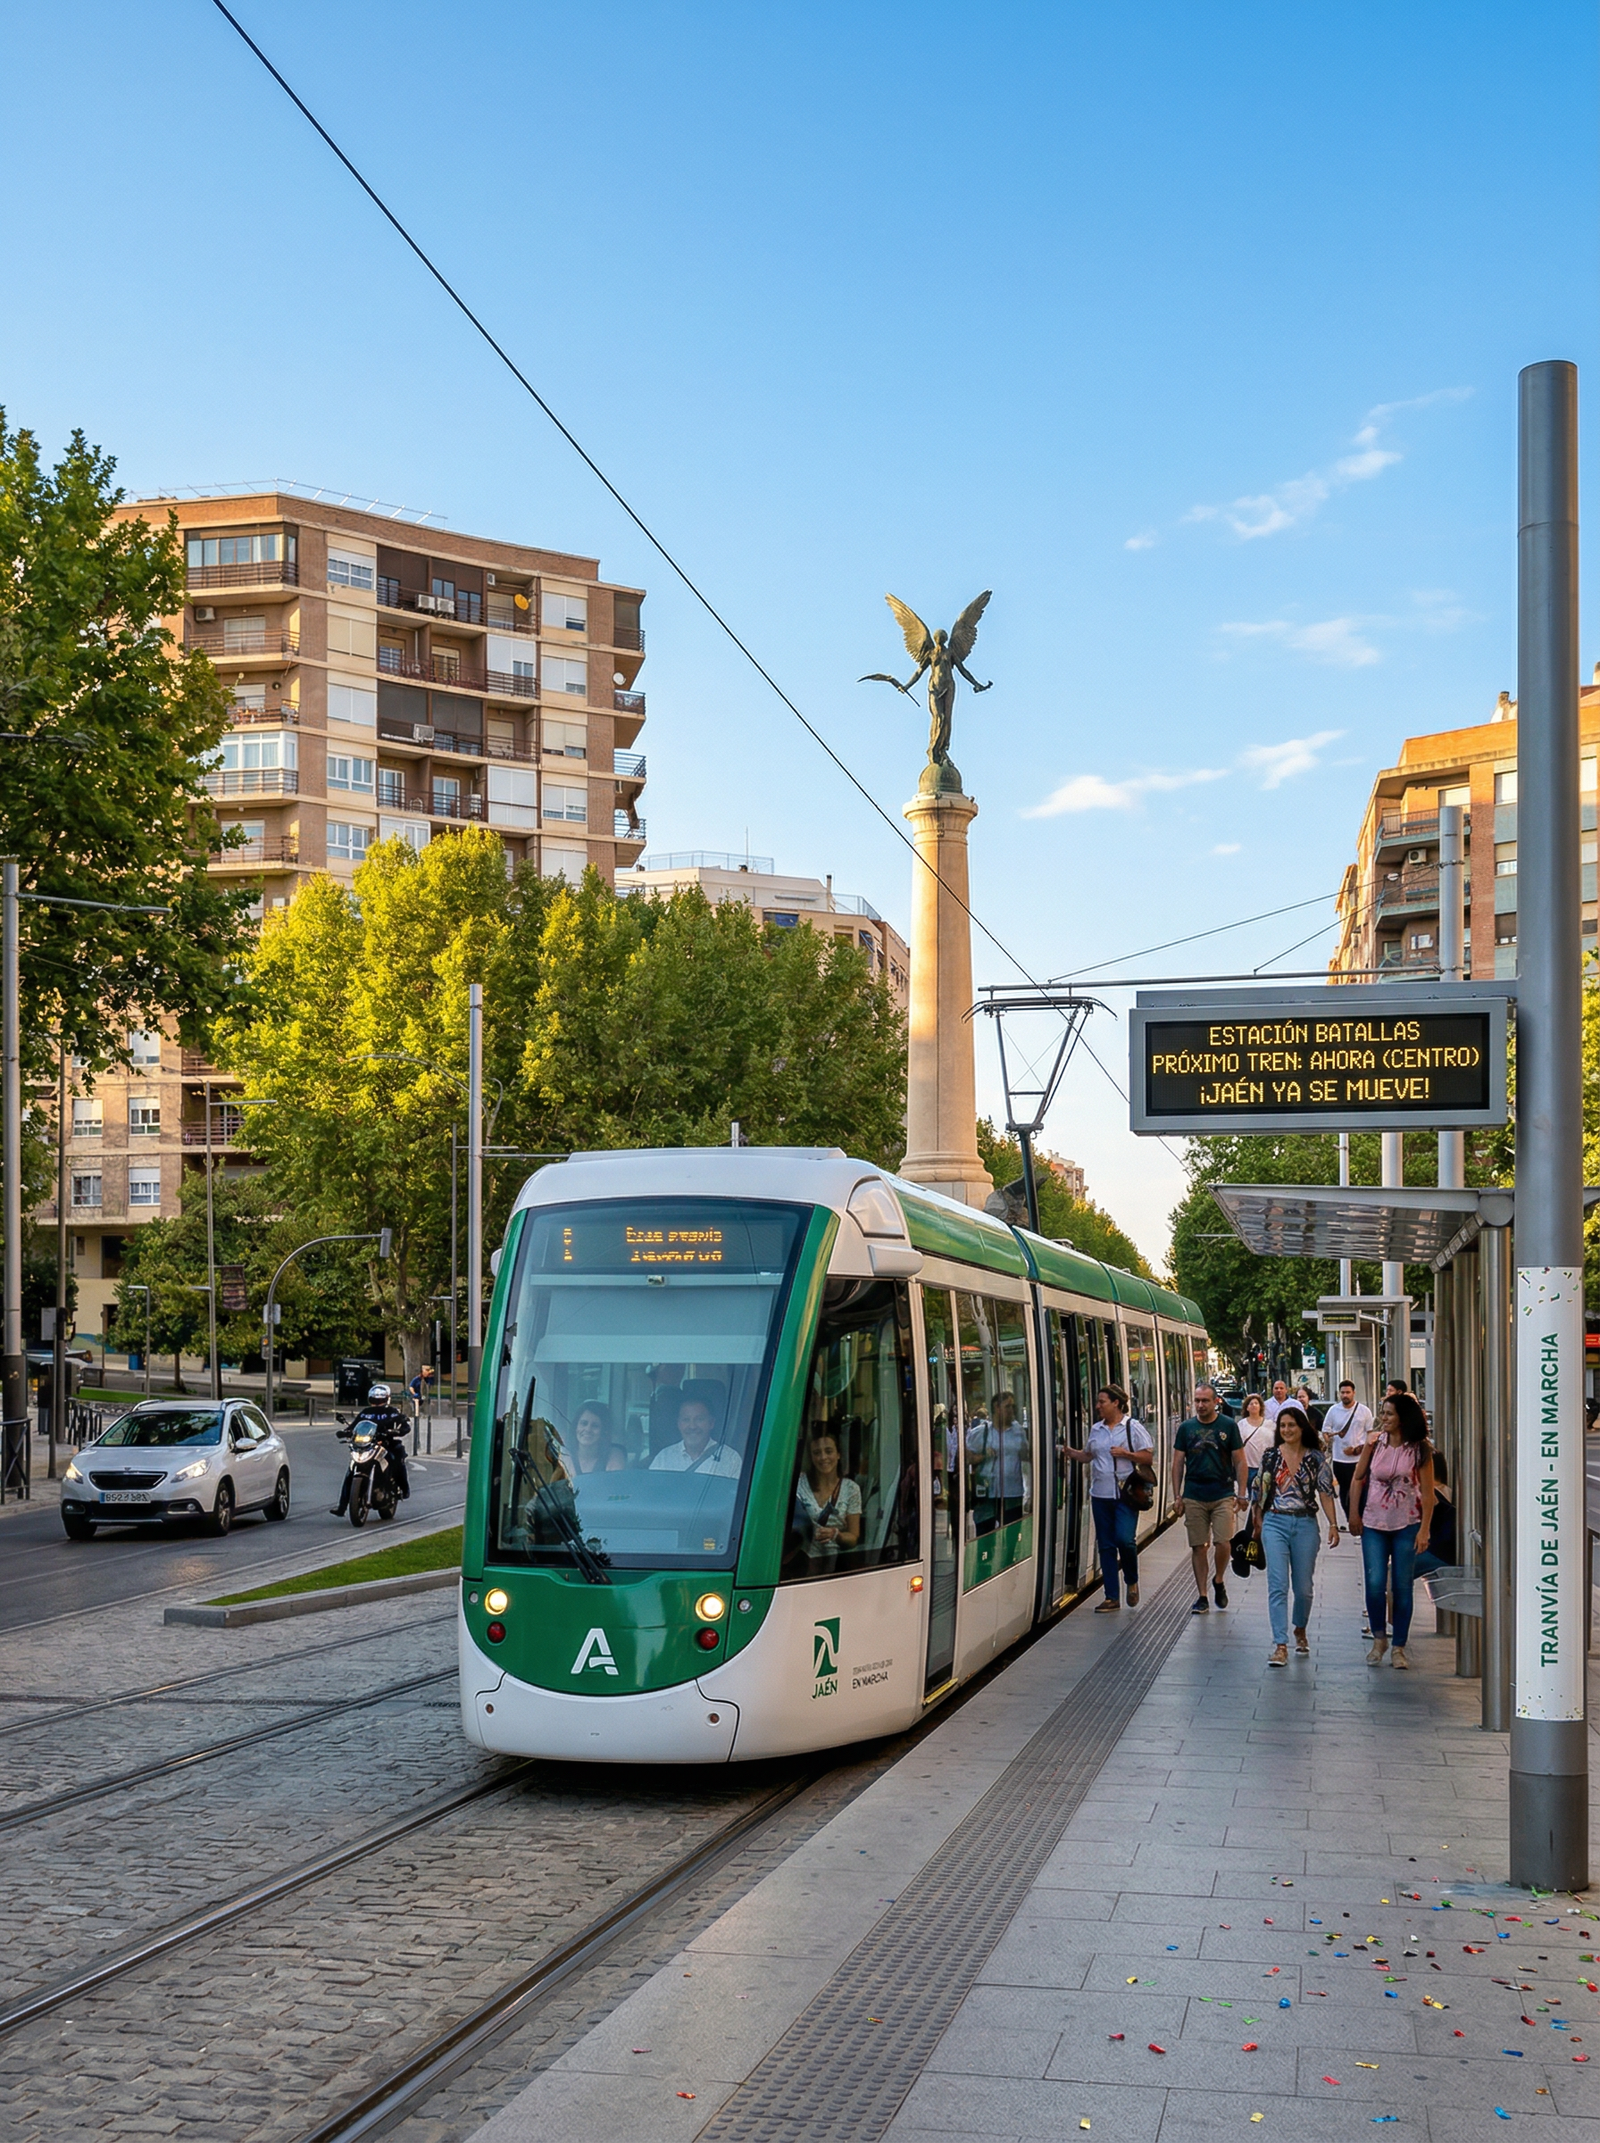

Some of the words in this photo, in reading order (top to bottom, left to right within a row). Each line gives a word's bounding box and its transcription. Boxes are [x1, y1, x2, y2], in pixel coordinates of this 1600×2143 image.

[1209, 1020, 1308, 1046] ESTACIÓN
[1315, 1021, 1421, 1043] BATALLAS
[1152, 1050, 1240, 1075] PRÓXIMO
[1249, 1051, 1303, 1073] TREN:
[1310, 1049, 1376, 1071] AHORA
[1382, 1046, 1481, 1069] (CENTRO)
[1200, 1077, 1264, 1105] ¡JAÉN
[1272, 1081, 1302, 1103] YA
[1309, 1080, 1339, 1102] SE
[1346, 1077, 1431, 1101] MUEVE!
[1540, 1332, 1559, 1424] MARCHA
[1540, 1431, 1559, 1458] EN
[1535, 1479, 1559, 1533] JAÉN
[1540, 1539, 1559, 1566] DE
[1535, 1572, 1559, 1668] TRANVÍA
[811, 1677, 838, 1700] JAÉN
